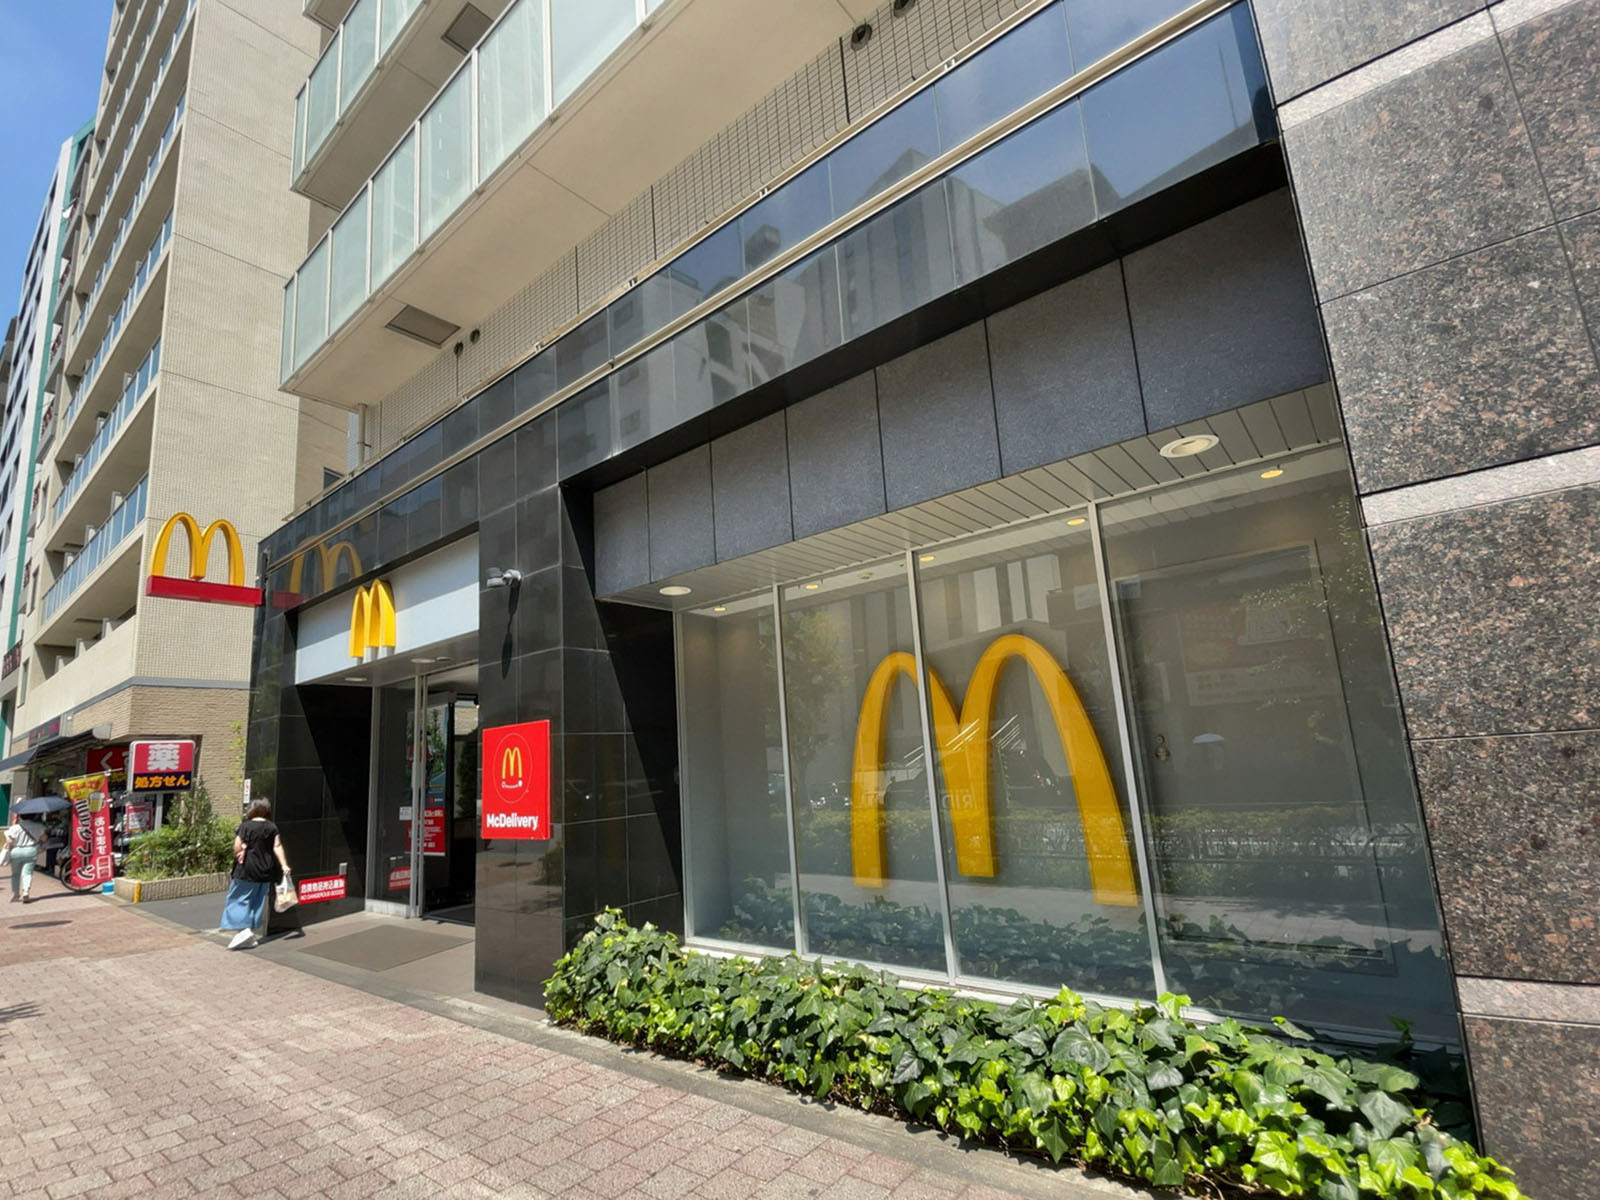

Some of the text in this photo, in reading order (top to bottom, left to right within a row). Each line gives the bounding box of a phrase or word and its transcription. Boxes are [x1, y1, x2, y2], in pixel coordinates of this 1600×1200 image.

[148, 744, 180, 770] 薬
[134, 774, 191, 789] 処方せん
[486, 811, 539, 831] McDelivery
